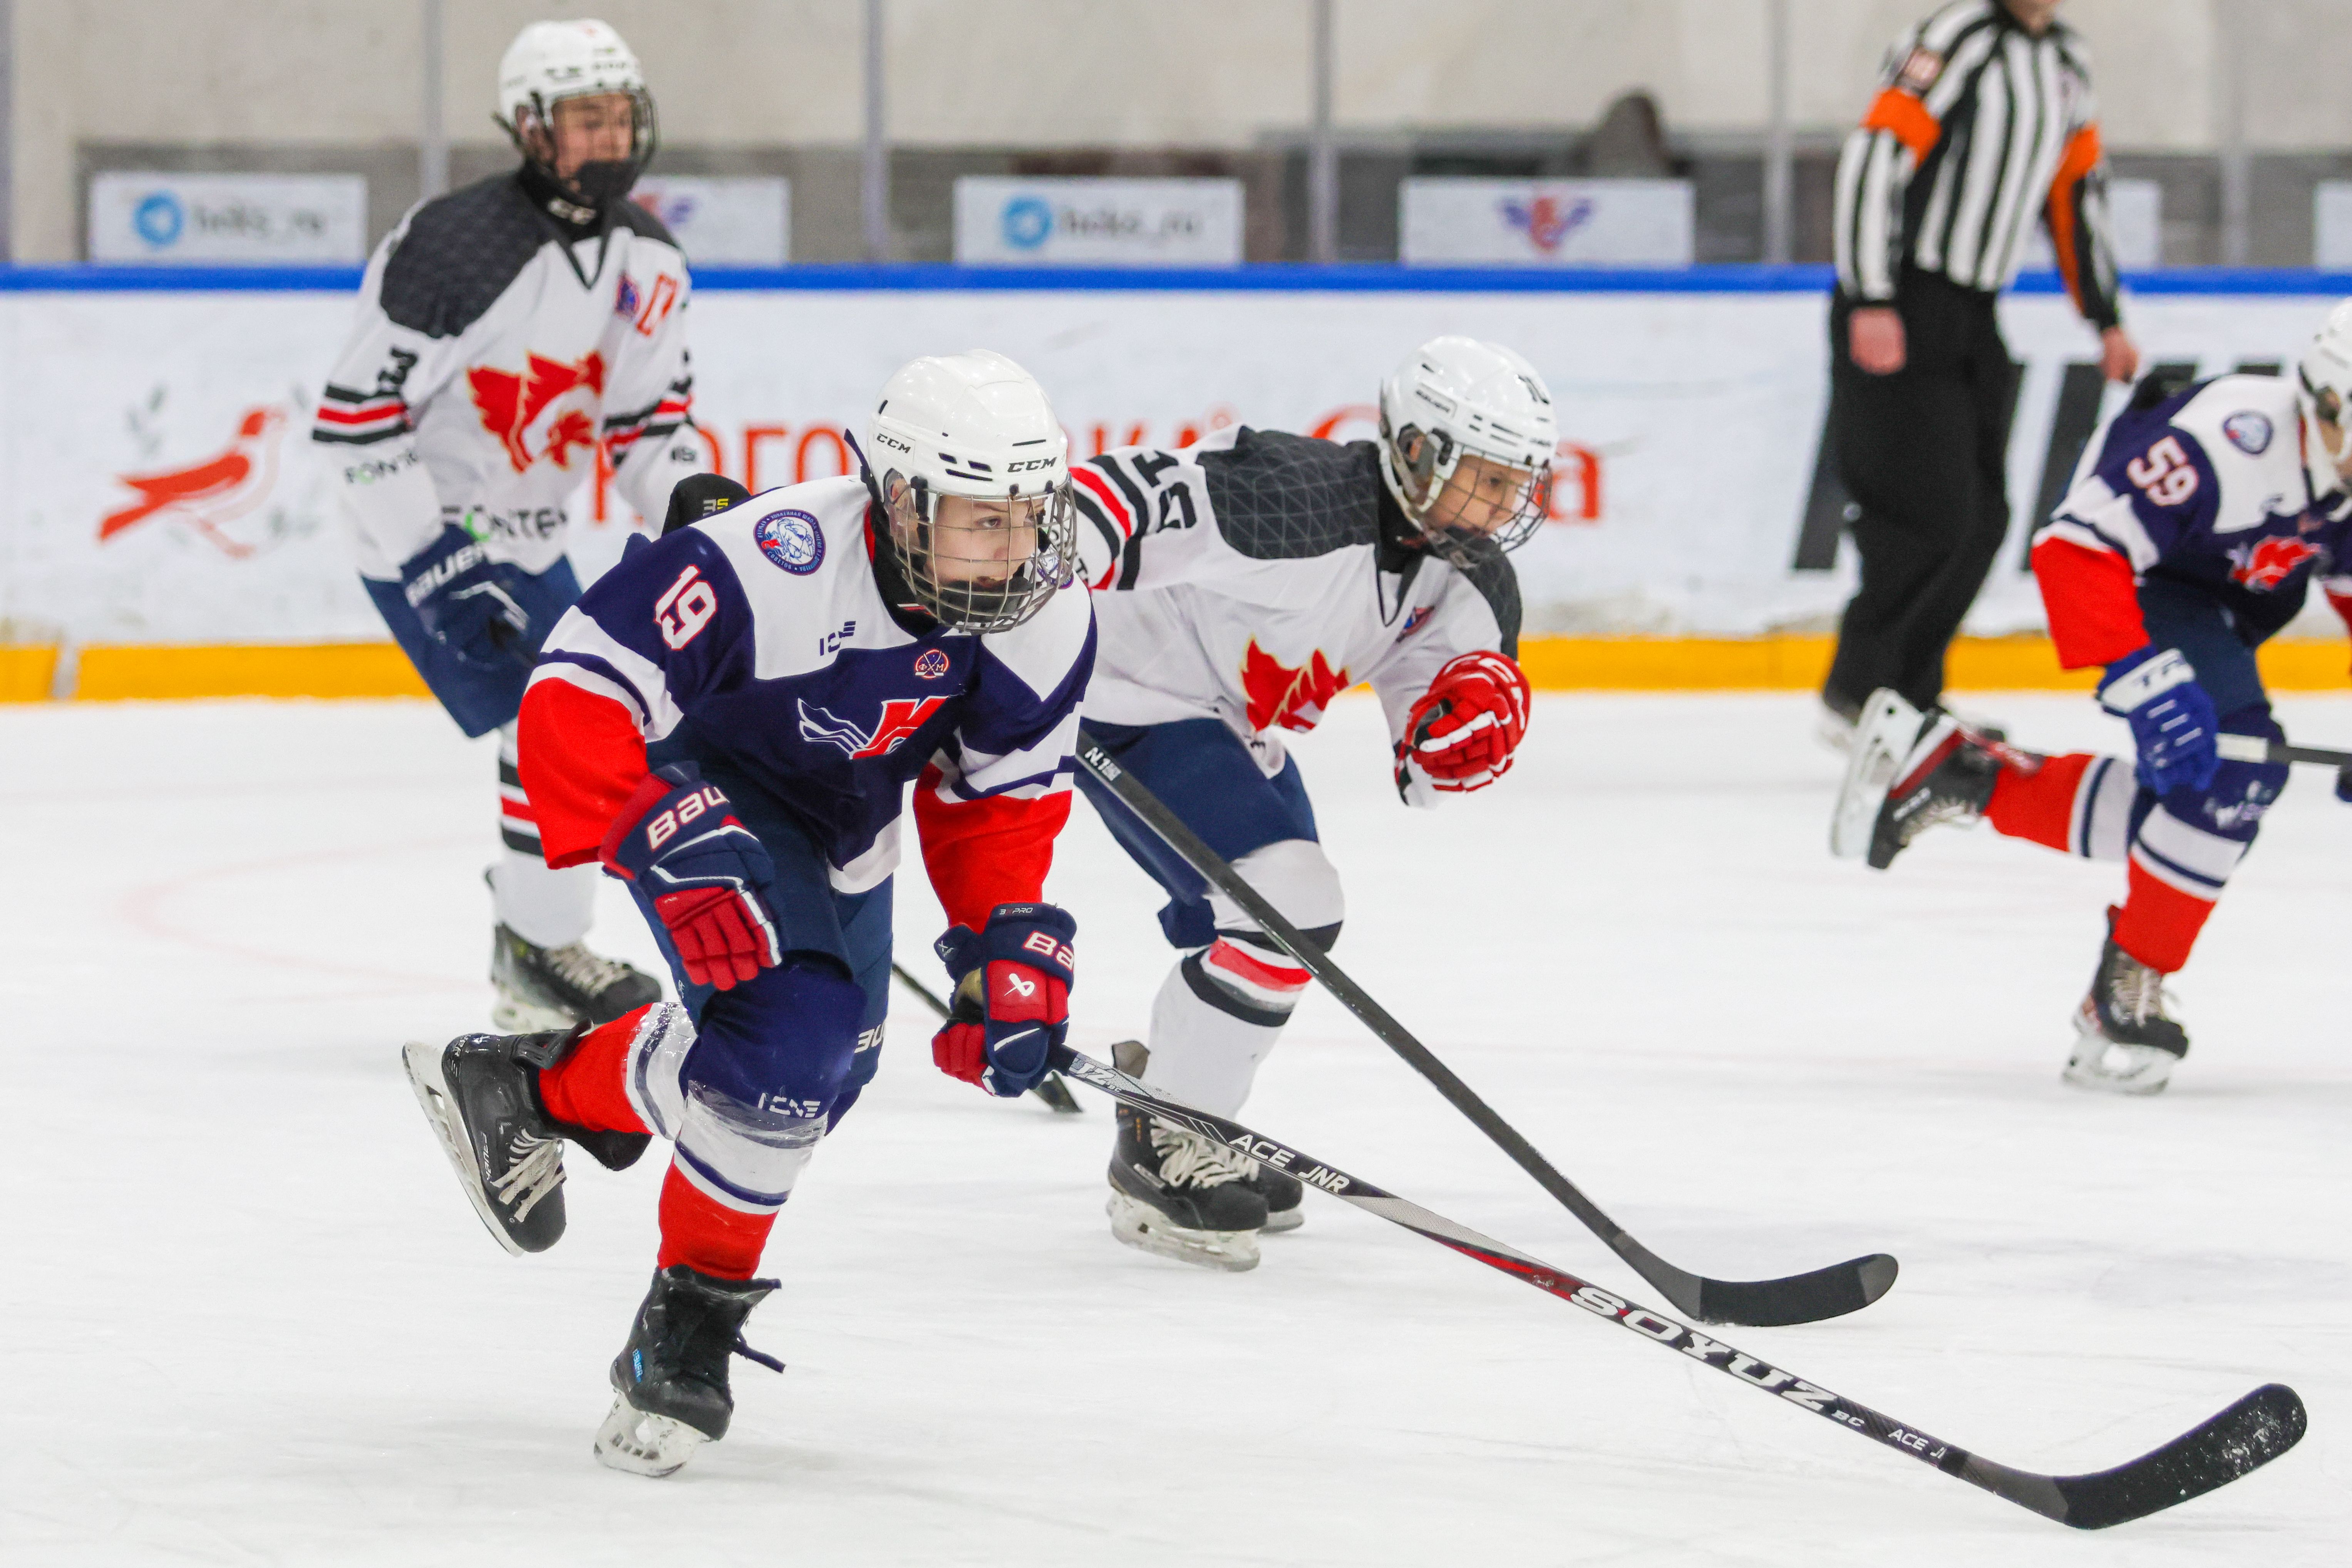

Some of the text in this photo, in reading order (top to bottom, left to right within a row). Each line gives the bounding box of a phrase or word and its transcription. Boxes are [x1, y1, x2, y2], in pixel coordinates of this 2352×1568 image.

[876, 433, 911, 454] CCM
[1007, 457, 1057, 473] CCM
[2126, 435, 2200, 506] 59
[653, 563, 718, 651] 19
[918, 662, 945, 672] ФХМ
[1228, 1133, 1350, 1194] ACE JNR
[1570, 1286, 1838, 1412] SOYUZ
[1831, 1409, 1865, 1427] BC
[1888, 1429, 1928, 1452] ACE
